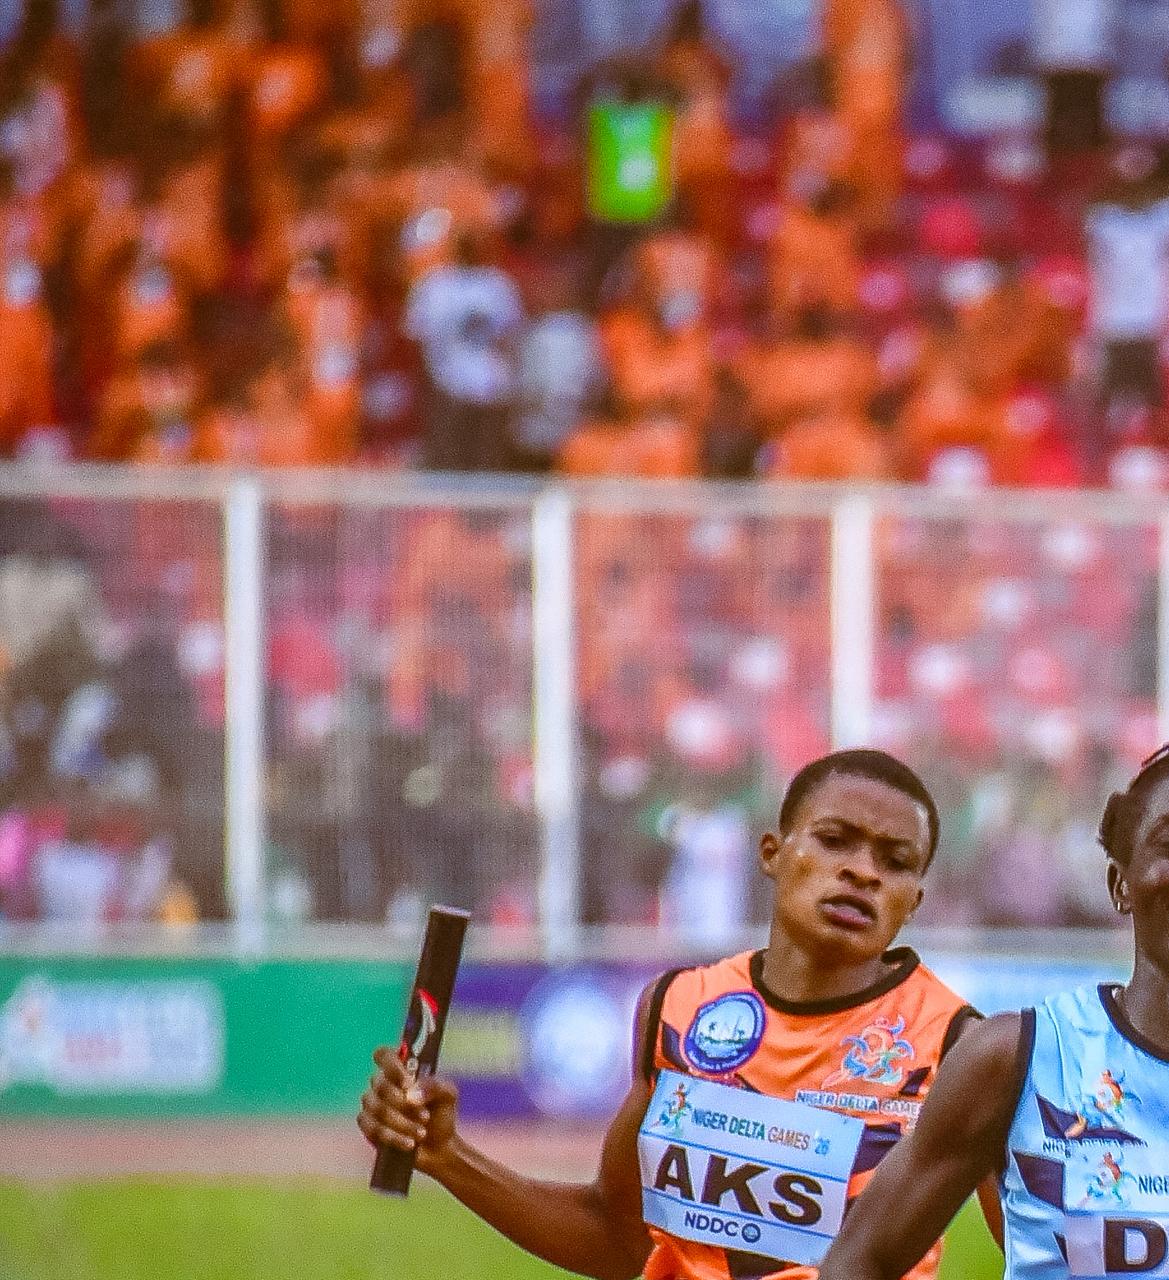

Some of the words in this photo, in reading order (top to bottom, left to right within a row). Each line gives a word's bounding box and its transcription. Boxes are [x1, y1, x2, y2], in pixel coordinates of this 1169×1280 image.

[838, 1095, 880, 1112] DELTA
[880, 1099, 921, 1117] GAME
[692, 1109, 729, 1131] NIGER
[728, 1115, 766, 1141] DELTA
[767, 1126, 811, 1151] GAMES
[653, 1143, 824, 1227] AKS
[684, 1209, 739, 1238] NDDC
